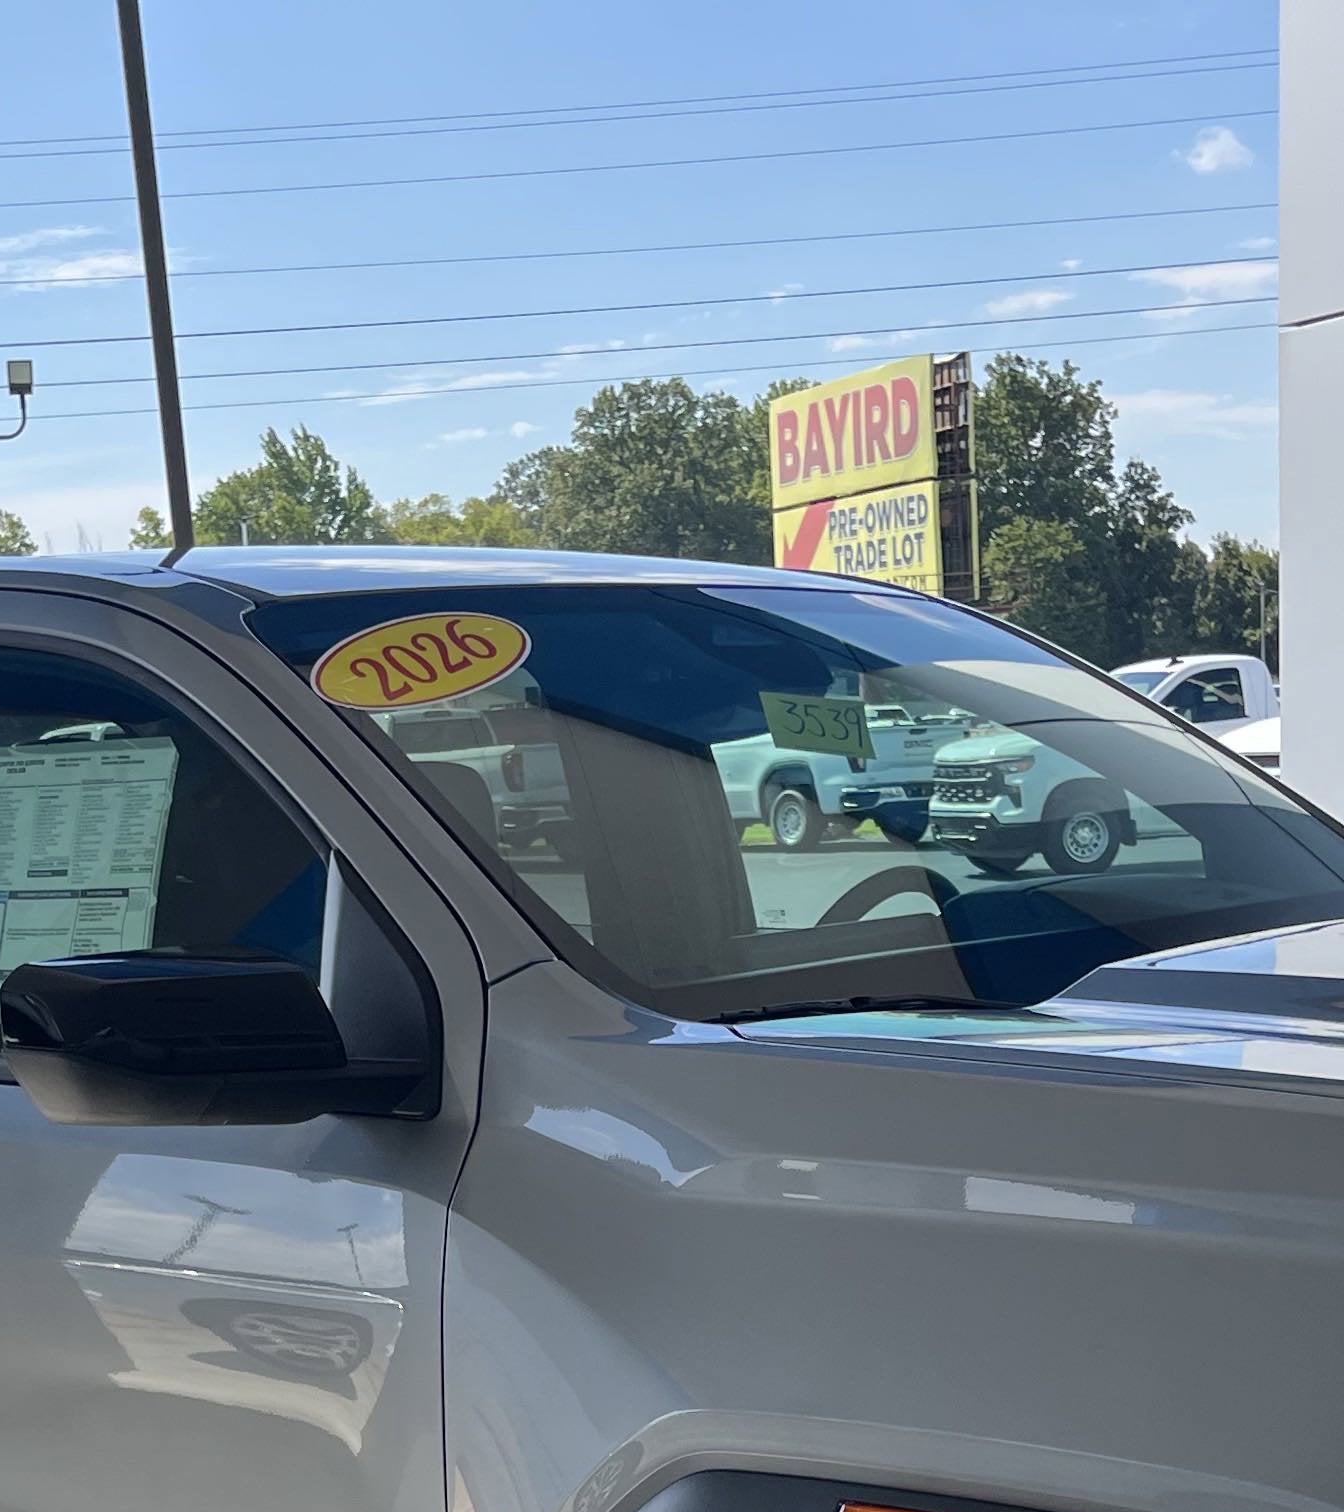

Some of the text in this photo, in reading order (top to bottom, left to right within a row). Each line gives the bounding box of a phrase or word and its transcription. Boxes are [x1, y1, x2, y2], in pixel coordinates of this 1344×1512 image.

[776, 376, 920, 488] BAYIRD
[829, 494, 928, 542] PRE-OWNED
[834, 532, 924, 573] TRADE LOT
[349, 619, 497, 700] 2026
[780, 700, 863, 749] 3539
